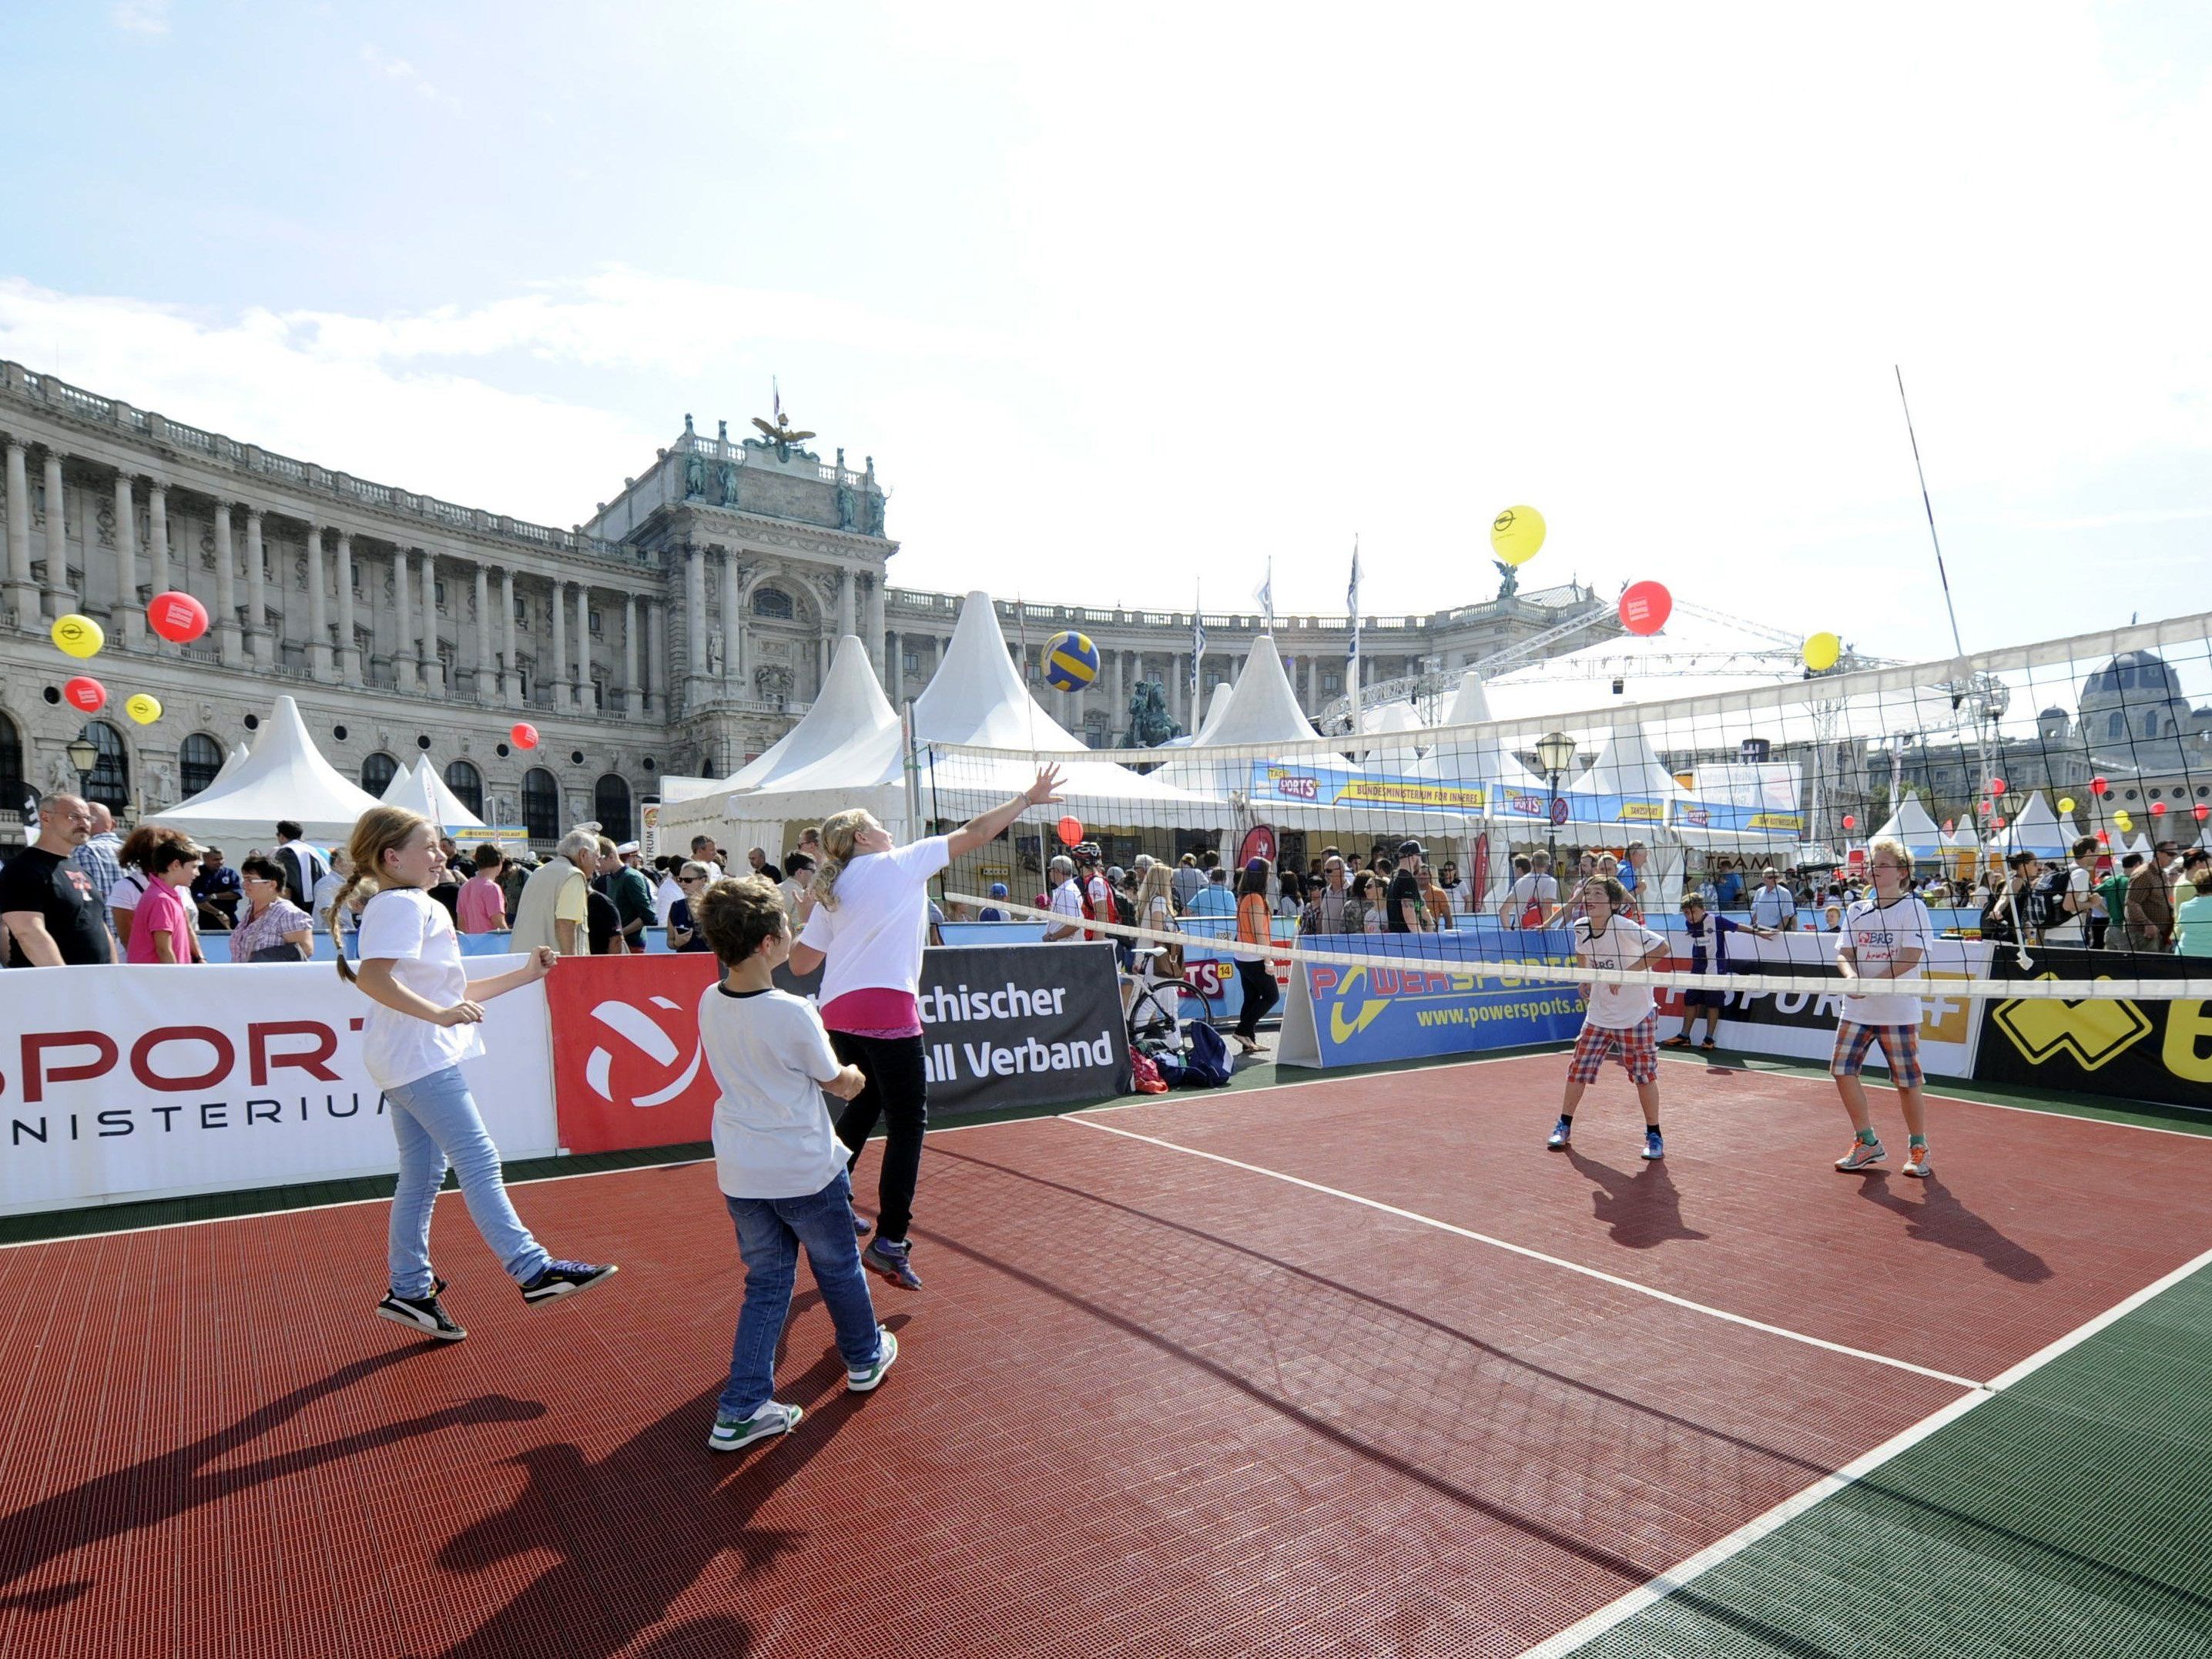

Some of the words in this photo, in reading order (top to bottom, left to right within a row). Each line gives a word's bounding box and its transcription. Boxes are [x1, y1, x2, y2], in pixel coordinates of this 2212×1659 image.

[1178, 964, 1220, 995] TS
[1219, 966, 1232, 976] 14
[0, 1017, 364, 1103] POR
[964, 1031, 1114, 1078] Verband
